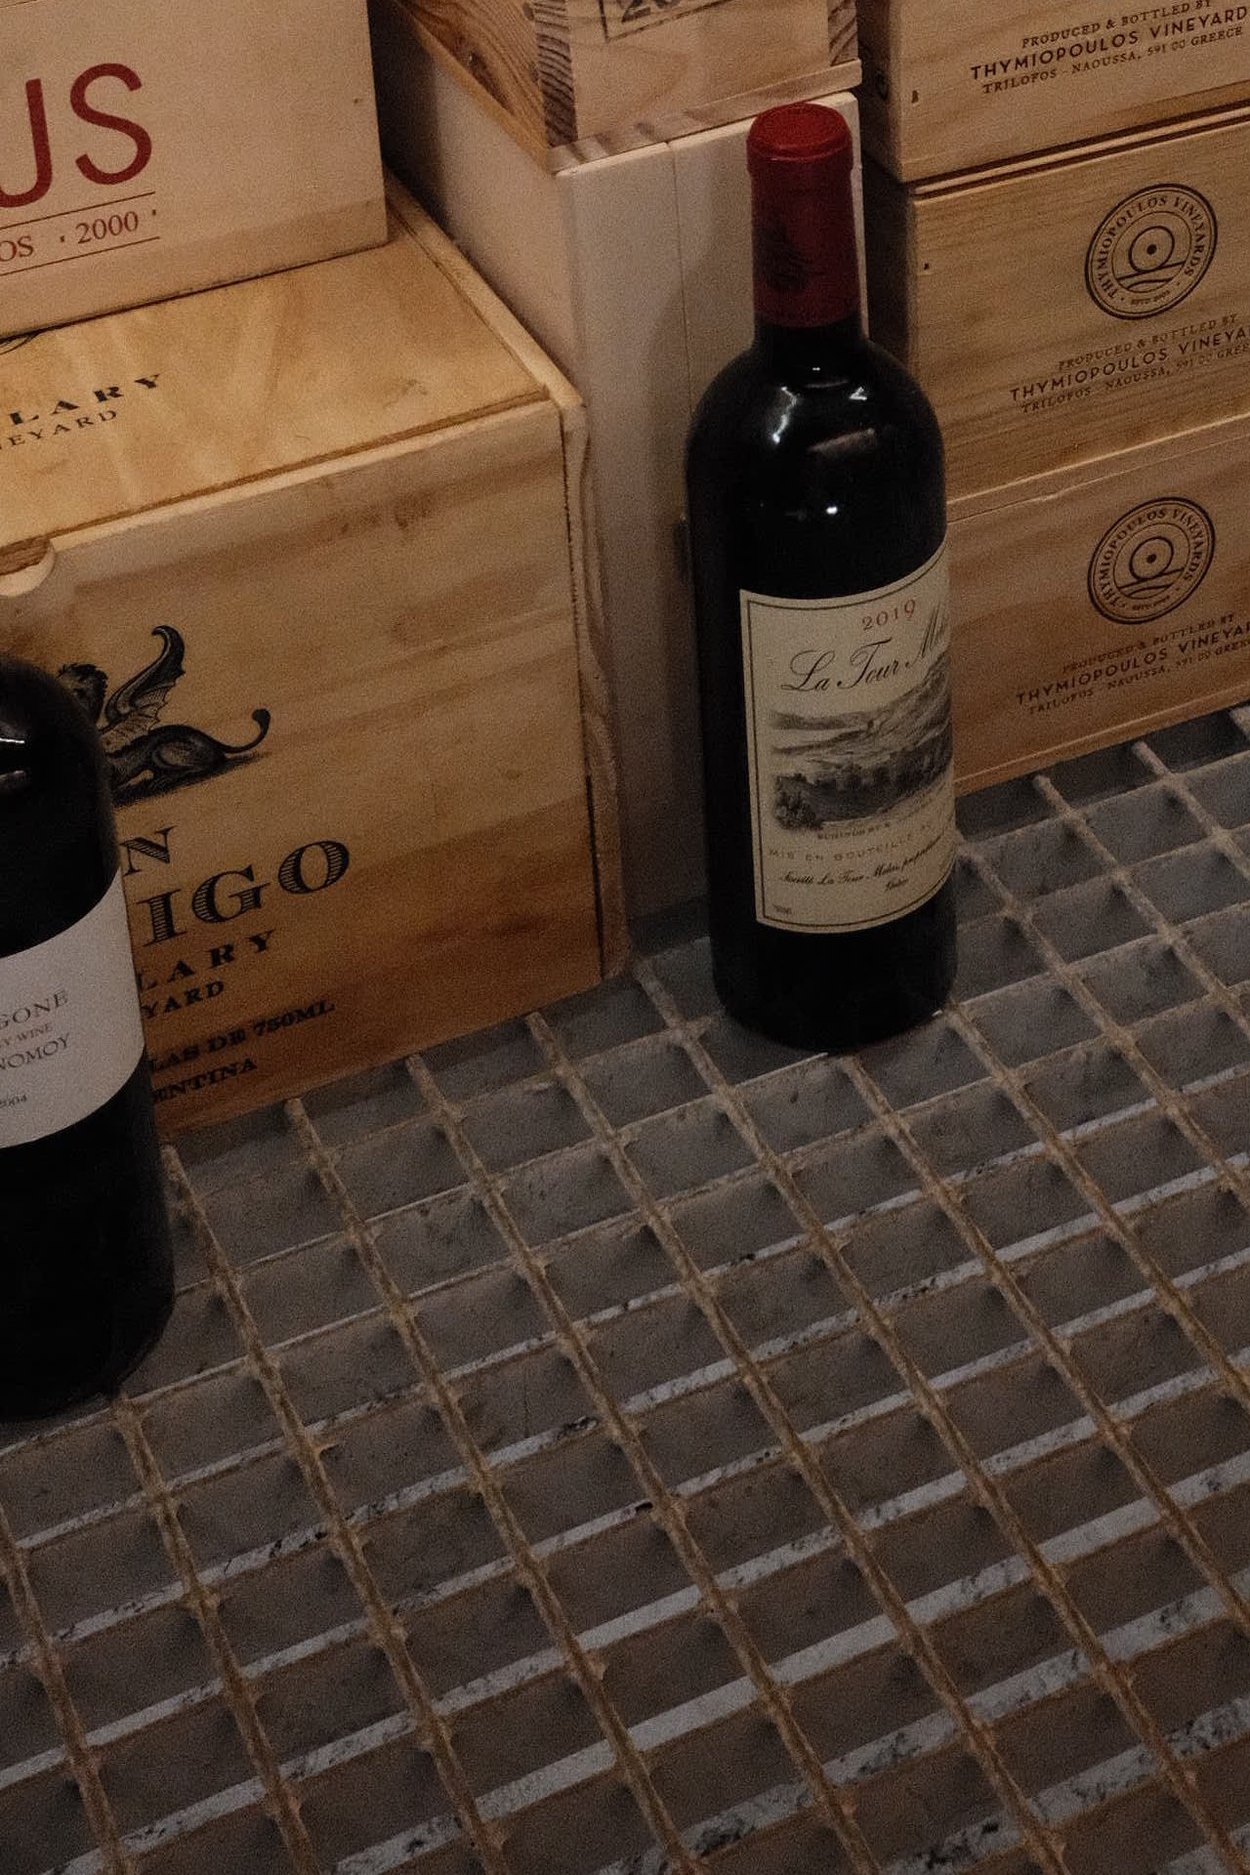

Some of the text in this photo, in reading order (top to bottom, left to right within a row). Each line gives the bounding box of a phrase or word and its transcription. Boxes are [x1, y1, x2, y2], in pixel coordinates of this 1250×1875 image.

[1021, 21, 1100, 49] PRODUCED
[1106, 18, 1116, 29] &
[1121, 1, 1190, 26] BOTTLED
[970, 30, 1139, 80] THYMIOPOULOS
[982, 67, 1058, 95] TRILOFOS
[1071, 51, 1142, 75] NAOUSSA,
[1190, 25, 1244, 48] GREECE
[76, 211, 139, 245] 2000
[1097, 195, 1207, 301] THYMIOPOULOS VINEYARDS
[1058, 342, 1132, 372] PRODUCED
[1152, 319, 1217, 343] BOTTLED
[1222, 313, 1238, 325] BY
[9, 373, 161, 425] LARY
[1010, 347, 1168, 402] THYMIOPOULOS
[0, 410, 117, 450] EYARD
[1100, 506, 1204, 608] THYMIOPOULOS VINEYARDS
[862, 599, 916, 631] 2019
[781, 636, 900, 692] La Tour
[1016, 648, 1169, 706] THYMIOPOULOS
[120, 825, 178, 877] N
[137, 839, 350, 948] IGO
[141, 981, 225, 1020] YARD
[209, 1028, 247, 1054] DE
[253, 999, 337, 1037] 750ML
[17, 1022, 54, 1041] WINE
